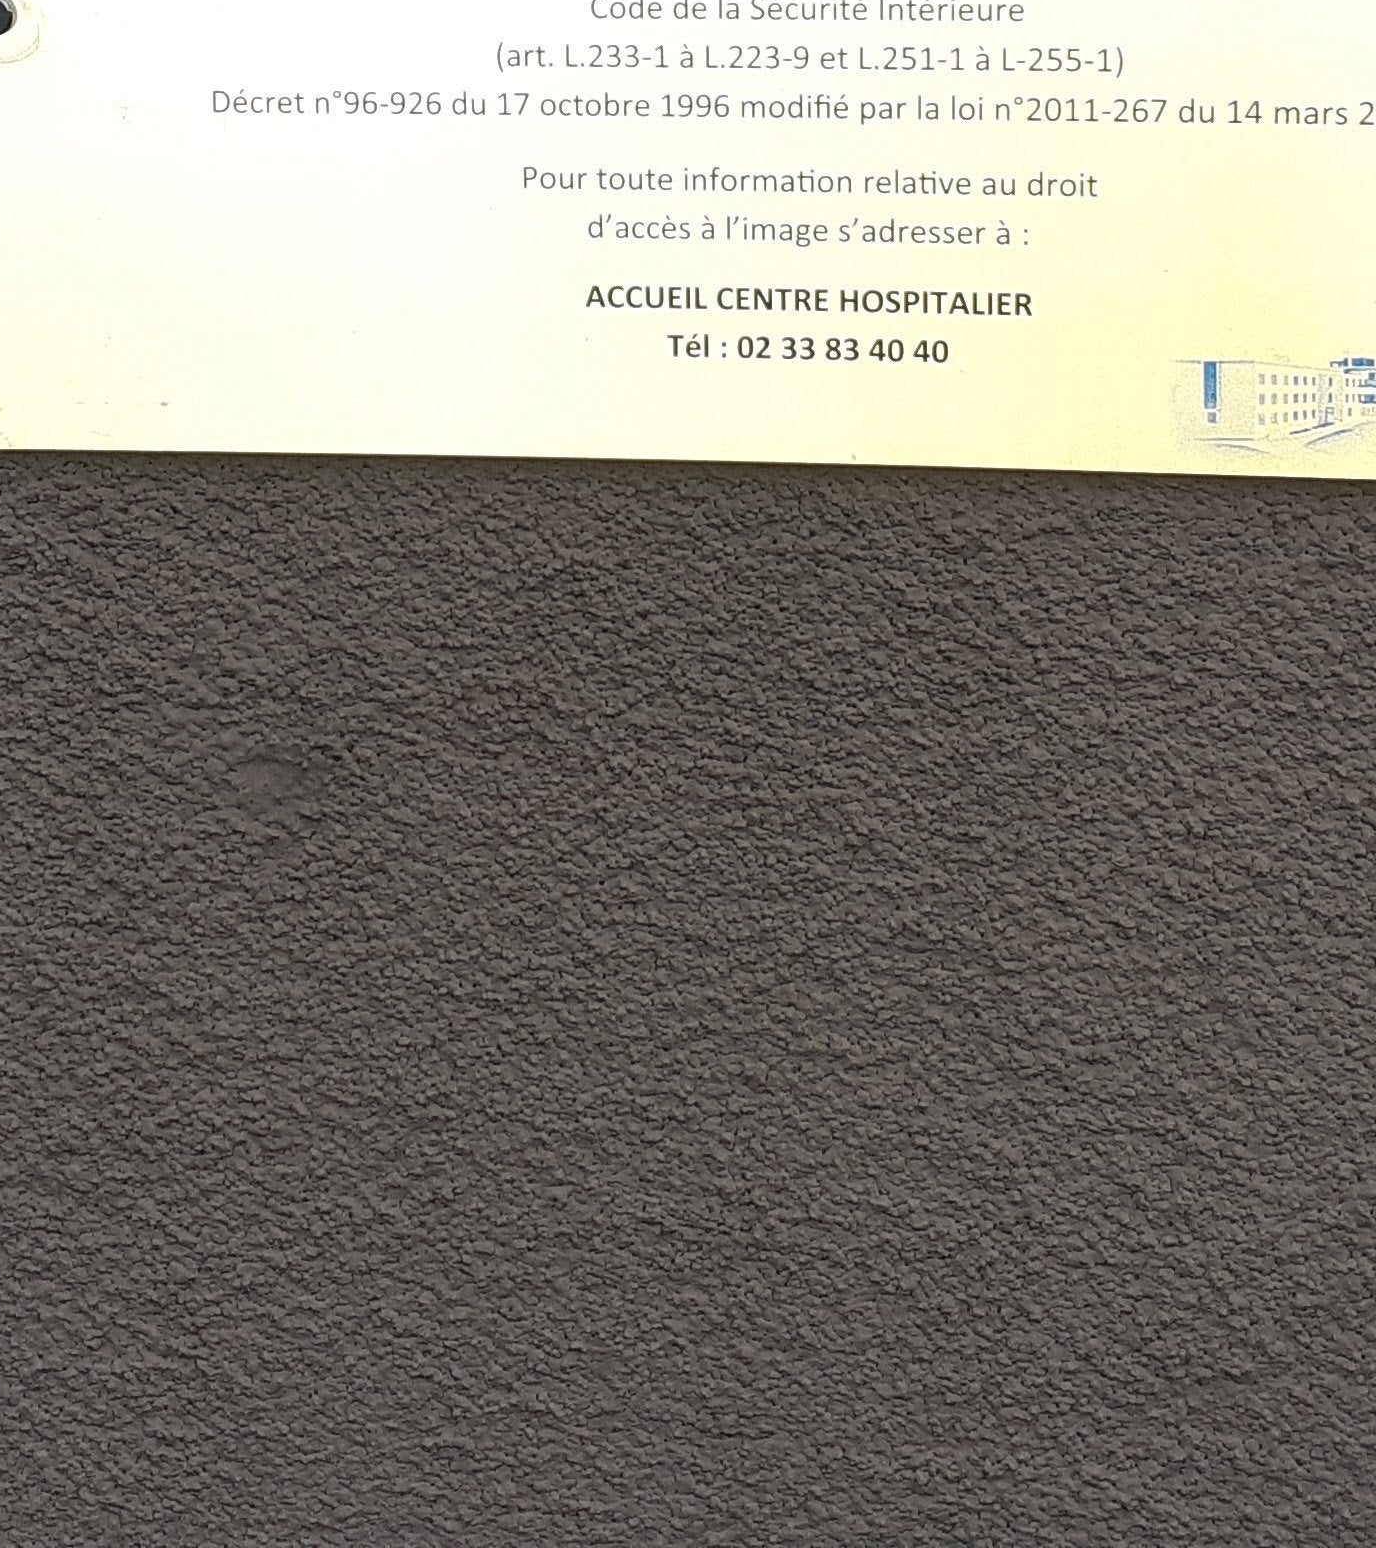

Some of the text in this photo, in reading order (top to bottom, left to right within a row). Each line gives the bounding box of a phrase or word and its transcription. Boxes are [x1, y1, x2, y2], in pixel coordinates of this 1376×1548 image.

[496, 41, 1124, 79] (art. L.233-1 à L.223-9 et L.251-1 à L-255-1)
[212, 88, 305, 114] Décret
[315, 90, 442, 116] n°96-926
[451, 90, 486, 116] du
[497, 92, 530, 116] 17
[540, 91, 651, 118] octobre
[661, 93, 730, 118] 1996
[741, 93, 849, 120] modifié
[860, 101, 907, 126] par
[917, 94, 939, 121] la
[951, 94, 984, 121] loi
[995, 96, 1168, 123] n°2011-267
[1178, 97, 1215, 124] du
[1227, 99, 1263, 125] 14
[1273, 106, 1348, 126] mars
[522, 166, 1098, 198] Pour toute information relative au droit
[701, 214, 715, 240] à
[995, 219, 1011, 246] à
[585, 285, 1033, 317] ACCUEIL CENTRE HOSPITALIER
[666, 333, 710, 359] Tél
[736, 335, 772, 360] 02
[781, 336, 816, 361] 33
[824, 337, 860, 362] 83
[868, 338, 905, 363] 40
[912, 339, 949, 364] 40
